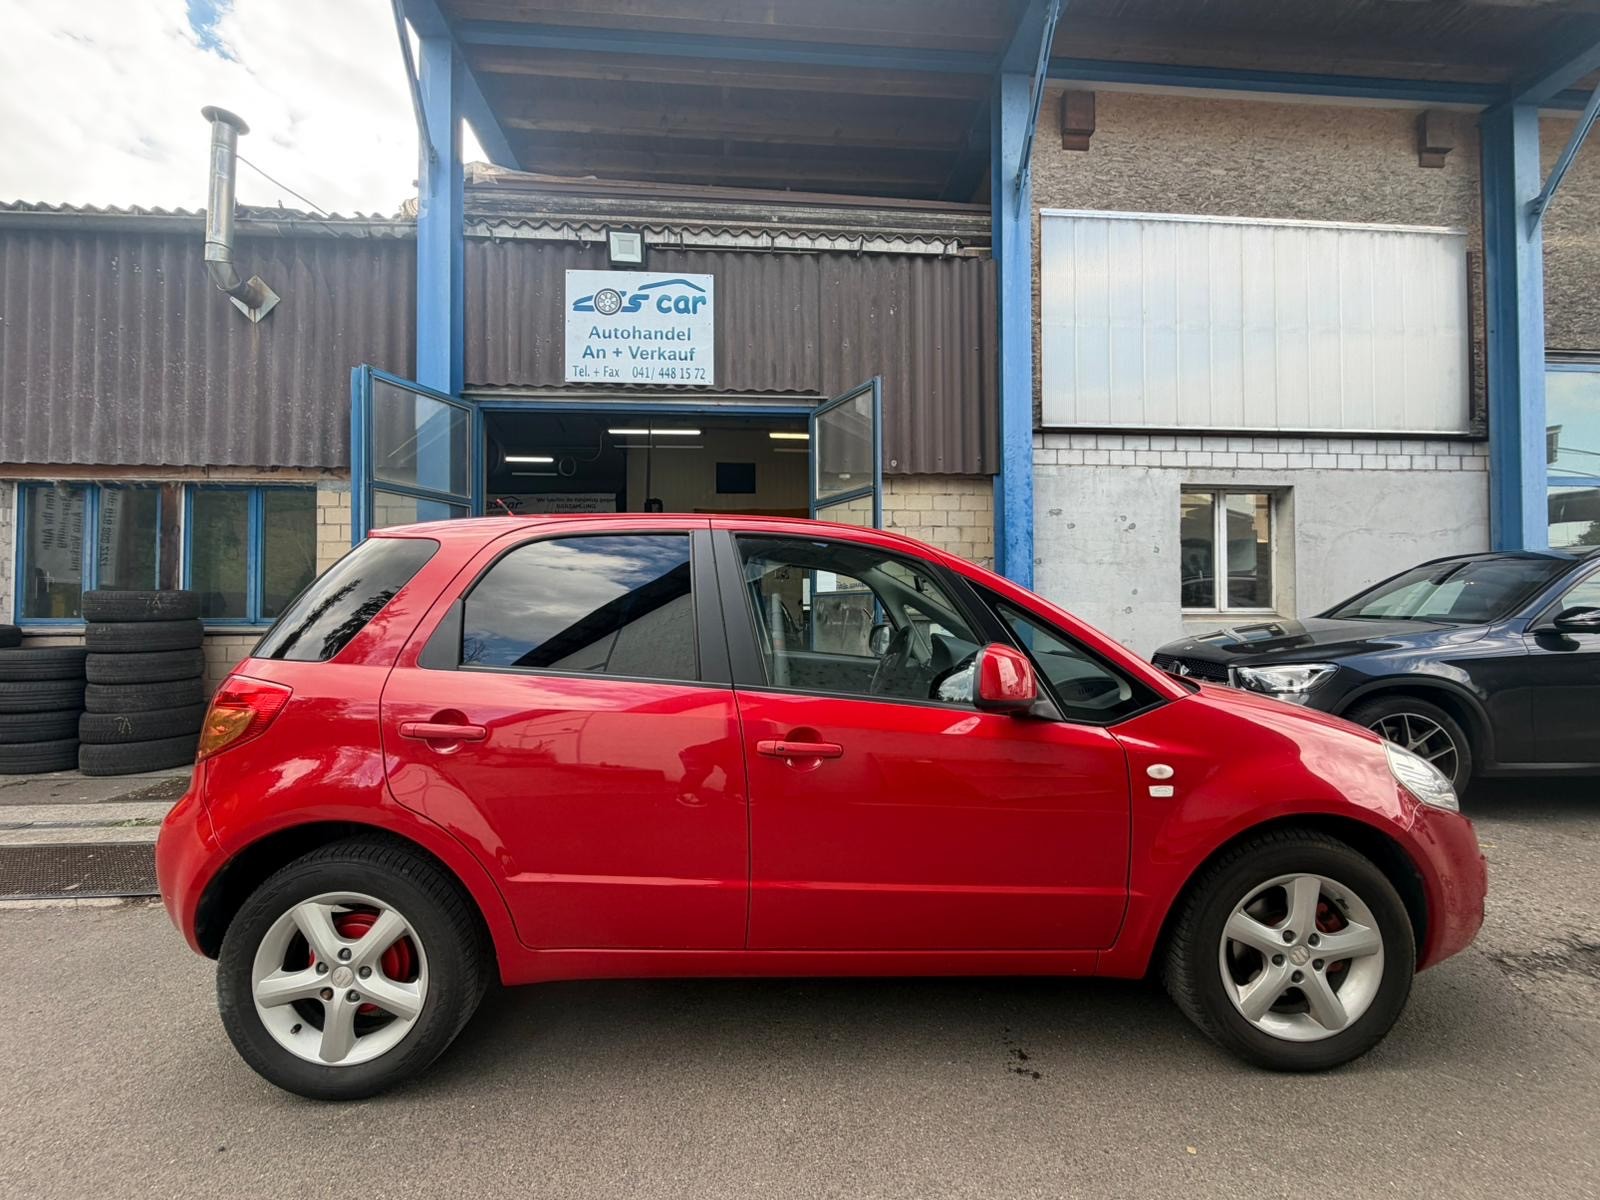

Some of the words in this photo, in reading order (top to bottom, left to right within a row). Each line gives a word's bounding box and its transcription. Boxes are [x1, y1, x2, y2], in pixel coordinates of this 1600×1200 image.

[656, 294, 707, 315] car
[589, 325, 692, 341] Autohandel
[582, 345, 607, 360] An
[613, 348, 622, 357] +
[628, 346, 696, 361] Verkauf
[572, 365, 590, 377] Tel.
[593, 368, 600, 376] +
[603, 366, 620, 378] Fax
[659, 367, 677, 379] 448
[680, 368, 691, 379] 15
[694, 368, 706, 380] 72
